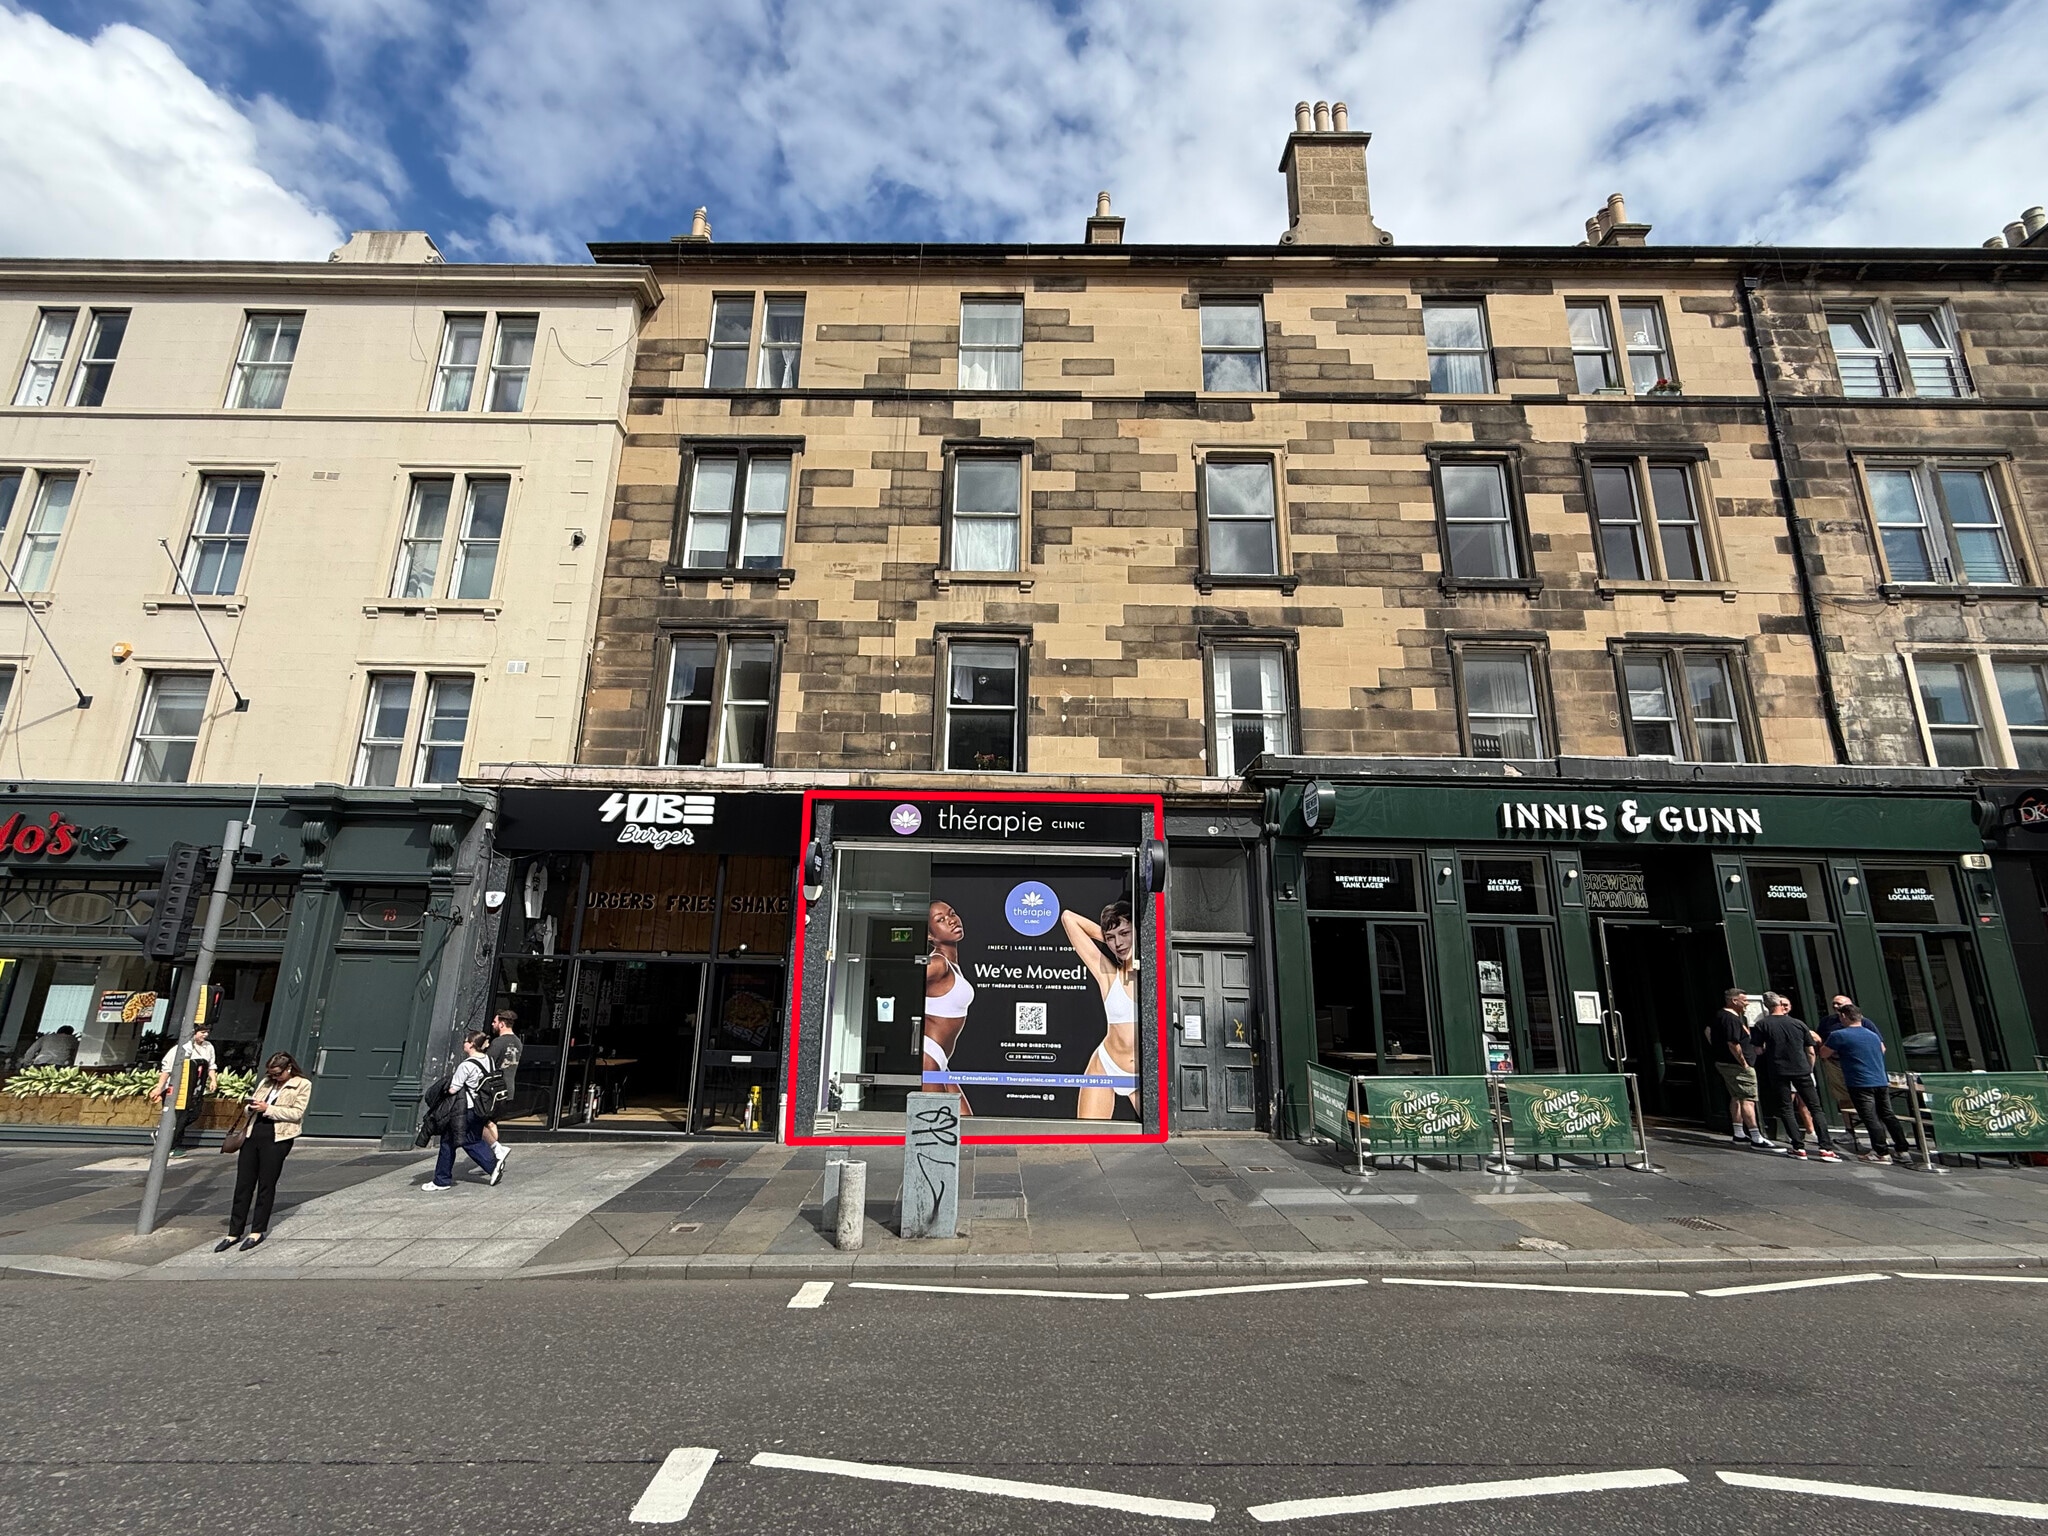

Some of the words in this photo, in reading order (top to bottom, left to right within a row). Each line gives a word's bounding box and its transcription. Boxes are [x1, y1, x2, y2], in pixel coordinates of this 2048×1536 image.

[598, 792, 716, 824] SOBE
[1502, 802, 1608, 831] INNIS
[1621, 799, 1651, 834] &
[1658, 806, 1763, 834] GUNN
[938, 804, 1043, 838] thérapie
[1051, 820, 1086, 830] CLINIC
[617, 823, 696, 850] Burger
[1583, 873, 1645, 890] BREWERY
[584, 891, 656, 910] URGERS
[1584, 890, 1649, 909] TAPROOM
[384, 908, 397, 922] 73
[1013, 907, 1052, 918] thérapie
[974, 963, 1023, 979] We've
[1026, 964, 1088, 981] Moved!
[1484, 1001, 1504, 1009] THE
[1403, 1091, 1440, 1114] INNIS
[1544, 1090, 1580, 1114] INNIS
[1965, 1088, 2002, 1111] INNIS
[1426, 1107, 1437, 1120] &
[1567, 1105, 1578, 1119] &
[1988, 1108, 2027, 1132] GUNN
[1989, 1103, 2001, 1117] &
[1423, 1112, 1461, 1135] GUNN
[1565, 1111, 1601, 1133] GUNN
